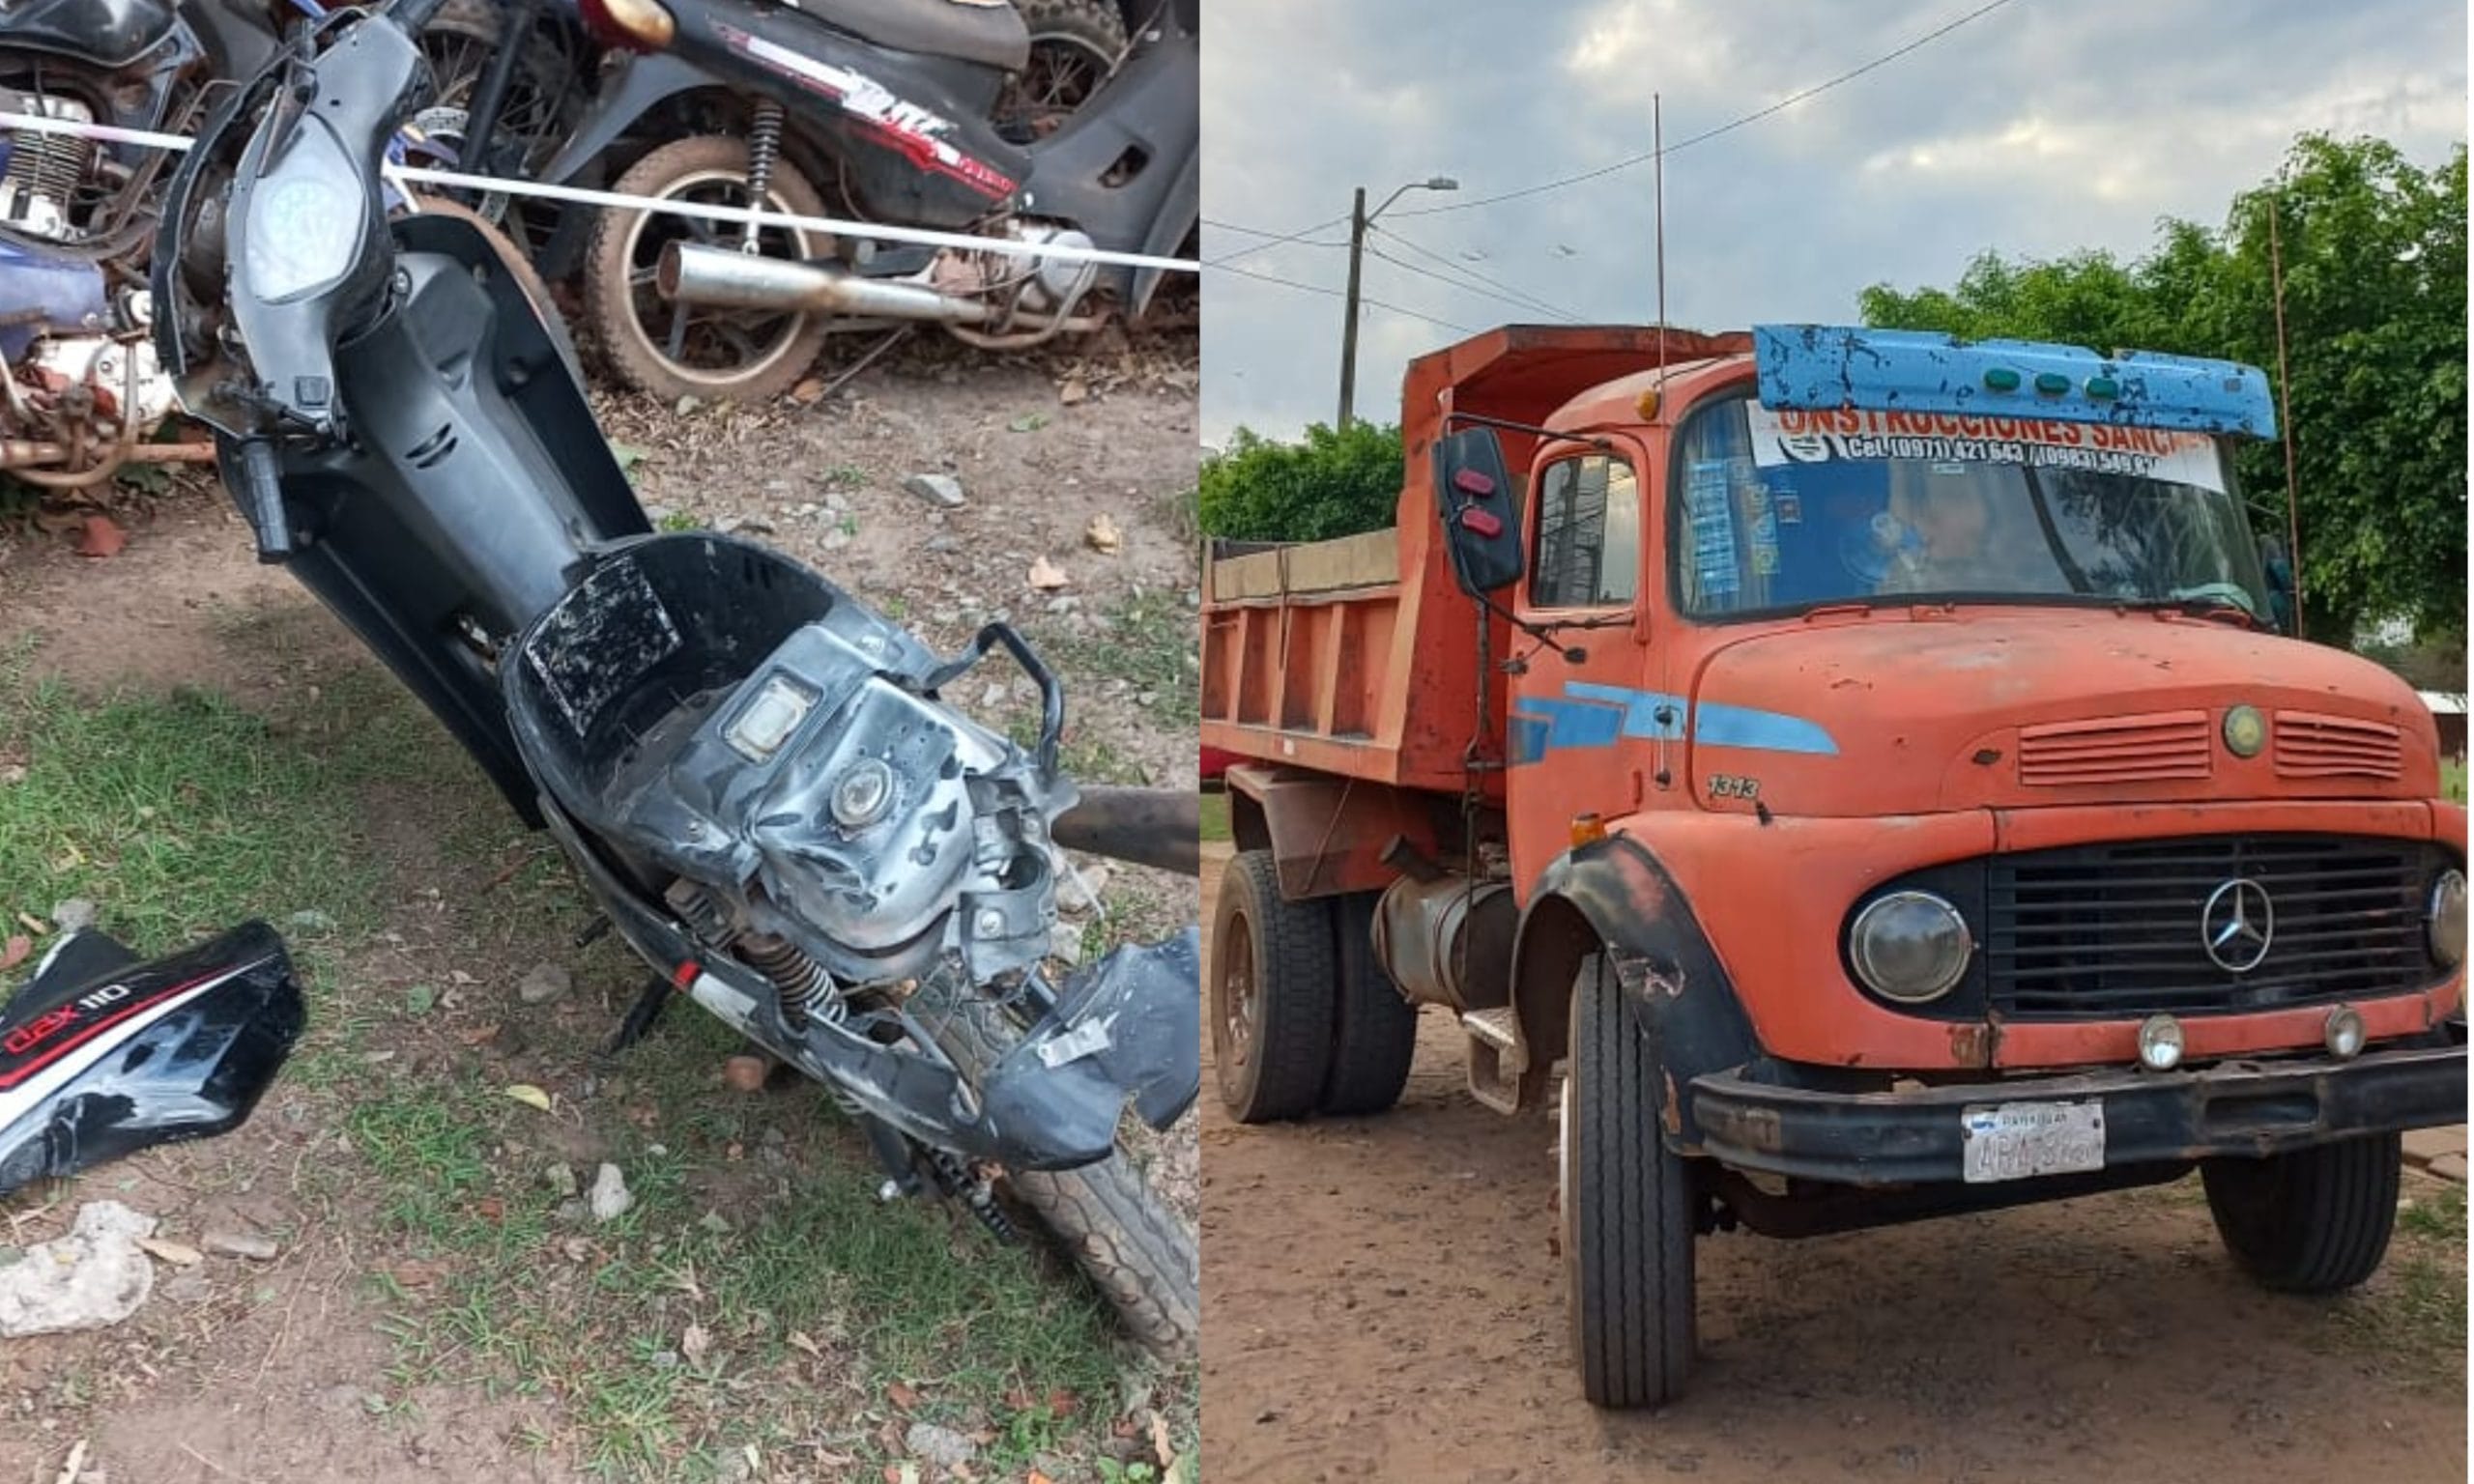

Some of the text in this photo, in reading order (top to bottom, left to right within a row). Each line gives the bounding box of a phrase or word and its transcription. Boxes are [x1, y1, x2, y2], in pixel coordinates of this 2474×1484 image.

[1774, 409, 2212, 456] ONSTRUCCIONES SANC
[1709, 774, 1759, 797] 1313
[78, 984, 130, 1010] 110
